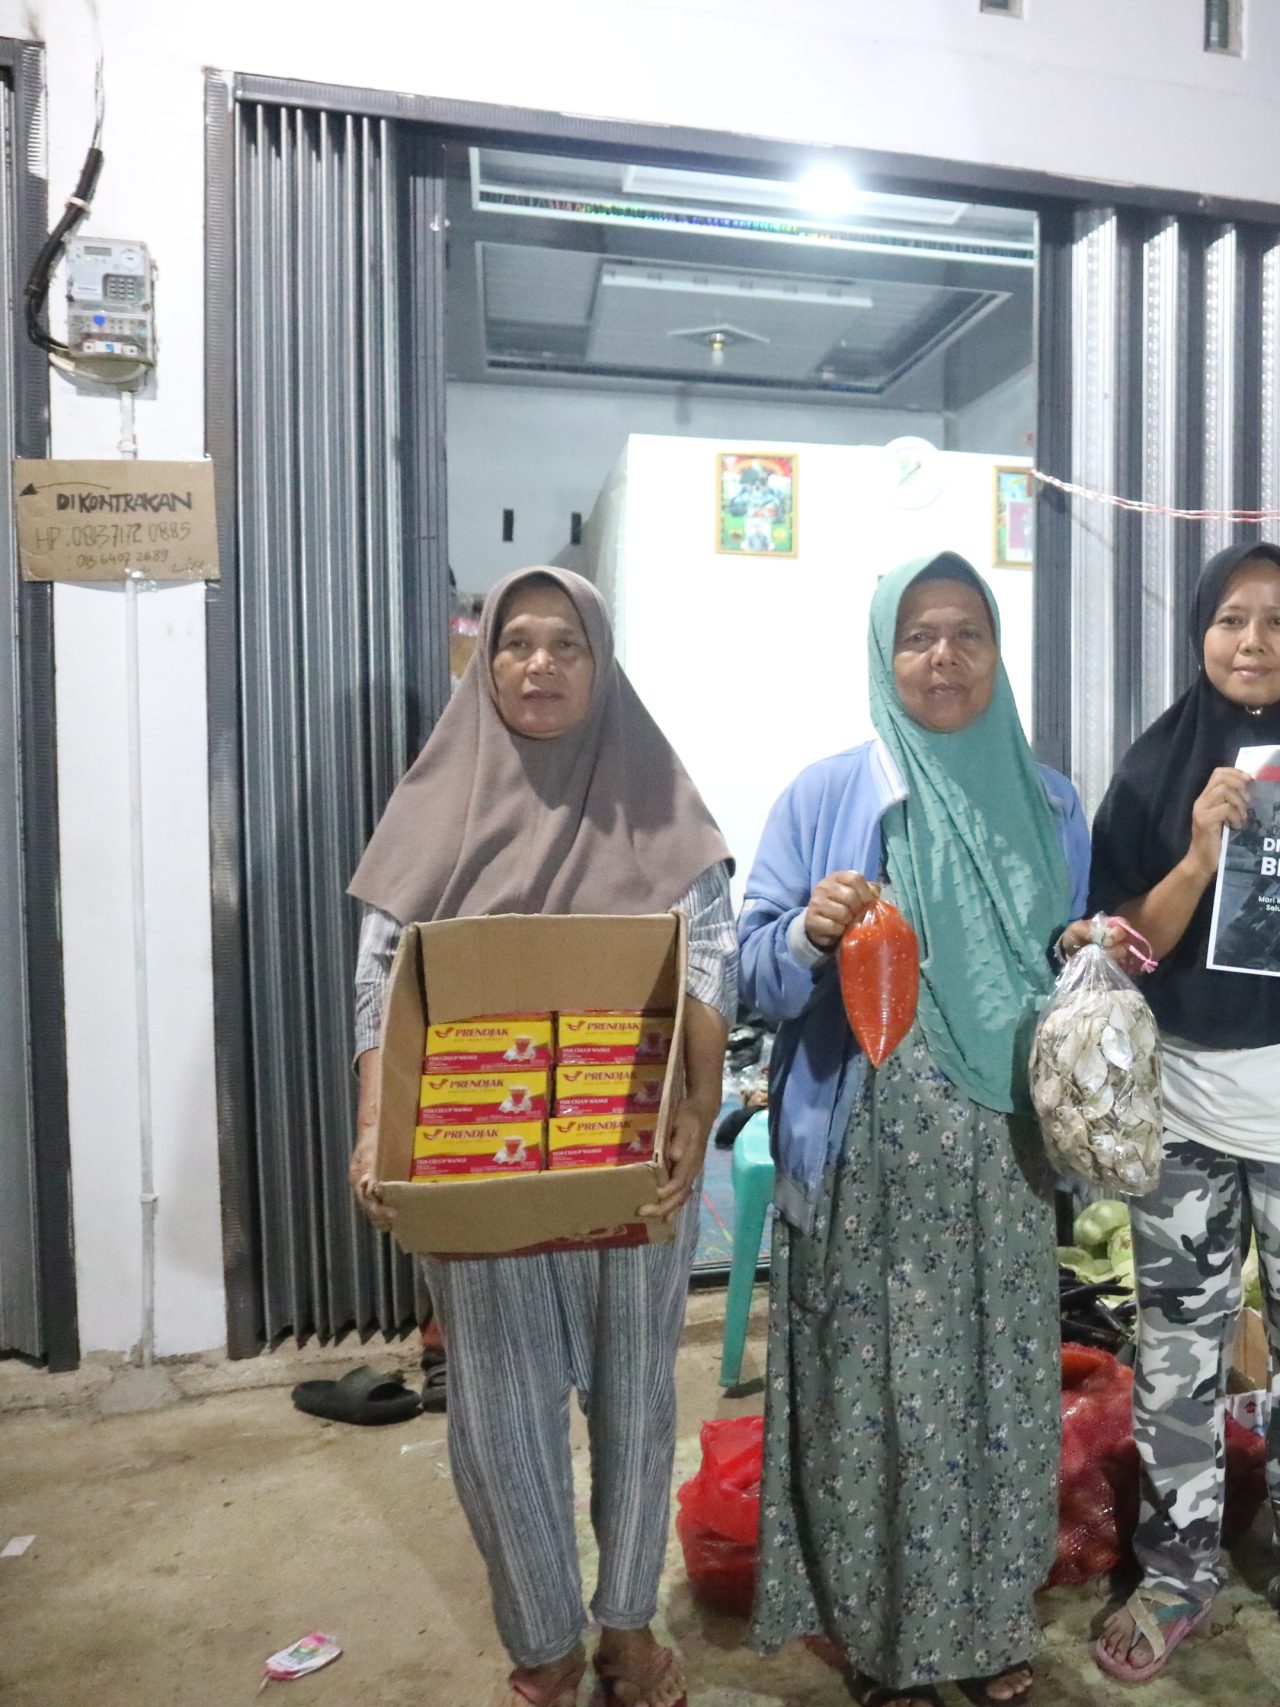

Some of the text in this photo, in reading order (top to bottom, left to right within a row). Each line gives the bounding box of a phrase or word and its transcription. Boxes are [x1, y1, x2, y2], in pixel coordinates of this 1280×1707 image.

[1258, 896, 1275, 904] Mari
[586, 1021, 640, 1031] PRENDJAK
[454, 1027, 510, 1038] PRENDJAK
[583, 1071, 638, 1081] PRENDJAK
[449, 1079, 505, 1089] PRENDJAK
[577, 1120, 632, 1131] PRENDJAK
[443, 1129, 499, 1139] PRENDJAK
